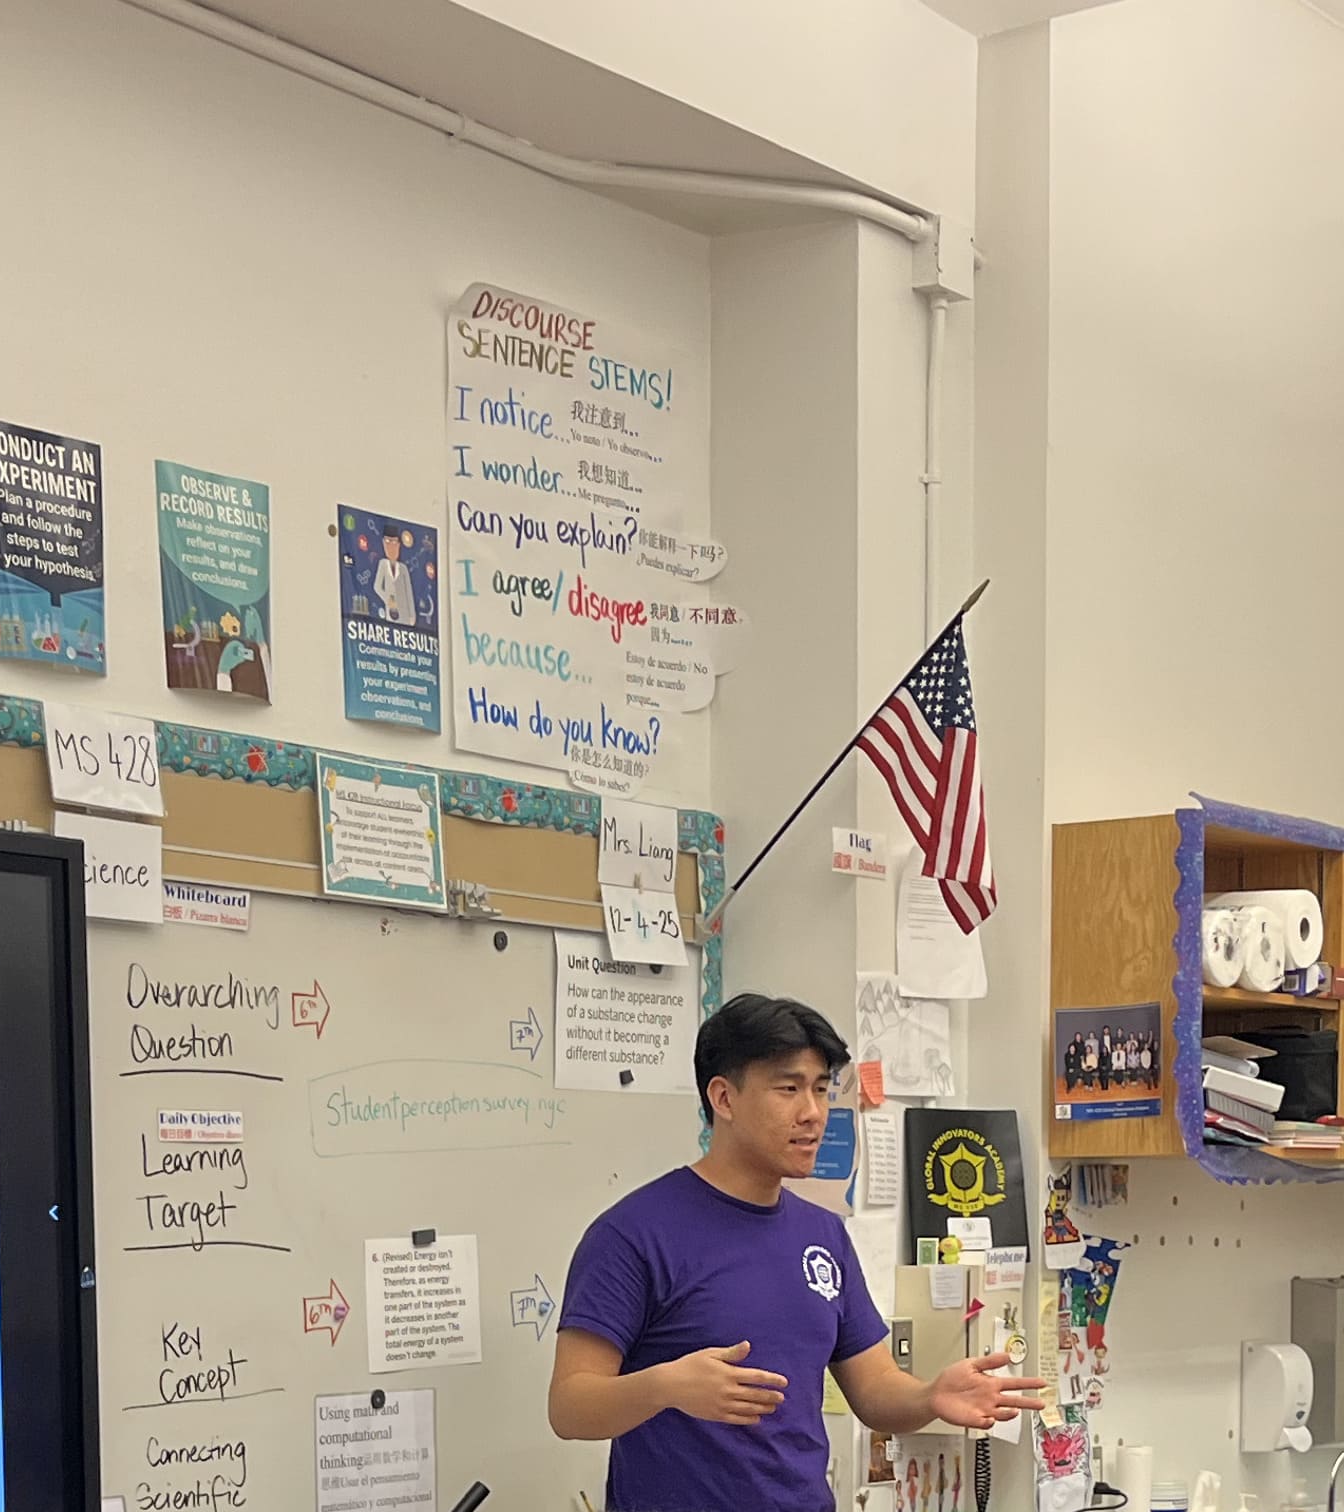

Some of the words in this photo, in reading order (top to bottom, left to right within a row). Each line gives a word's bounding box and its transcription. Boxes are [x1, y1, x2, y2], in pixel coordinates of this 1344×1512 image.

[471, 290, 597, 350] DISCOURSE
[457, 319, 576, 379] SENTENCE
[588, 355, 673, 412] STEMS!
[454, 385, 473, 422] I
[71, 448, 95, 477] AN
[453, 445, 474, 477] I
[180, 474, 239, 506] OBSERVE
[241, 488, 253, 508] &
[1, 510, 25, 527] and
[27, 514, 62, 535] follow
[64, 522, 83, 540] the
[25, 496, 33, 509] a
[35, 499, 93, 522] procedure
[160, 492, 215, 521] RECORD
[217, 505, 269, 534] RESULTS
[6, 533, 40, 552] steps
[42, 538, 54, 553] to
[56, 541, 79, 558] test
[457, 500, 503, 537] Can
[509, 512, 548, 549] you
[556, 512, 639, 568] explain?
[3, 553, 32, 569] your
[34, 554, 96, 582] hypothesis.
[456, 559, 479, 596] I
[567, 573, 648, 644] disagree
[347, 620, 392, 645] SHARE
[393, 628, 439, 657] RESULTS
[469, 686, 519, 731] How
[529, 699, 553, 739] do
[559, 717, 593, 756] you
[601, 702, 661, 756] know?
[56, 729, 99, 776] MS
[108, 731, 156, 788] 428
[603, 816, 632, 855] Mrs.
[638, 820, 675, 882] Liang
[84, 855, 149, 887] cience
[164, 884, 247, 908] Whiteboard
[567, 954, 589, 970] Unit
[592, 957, 636, 975] Question
[127, 963, 281, 1030] Overarching
[567, 983, 589, 999] How
[591, 987, 608, 1000] can
[610, 987, 626, 1002] the
[627, 991, 684, 1007] appearance
[566, 1005, 577, 1018] of
[579, 1007, 585, 1019] a
[587, 1006, 636, 1024] substance
[637, 1011, 673, 1029] change
[129, 1023, 234, 1063] Question
[566, 1025, 603, 1040] without
[605, 1028, 612, 1041] it
[614, 1027, 661, 1048] becoming
[663, 1035, 670, 1046] a
[565, 1045, 608, 1062] different
[609, 1048, 665, 1065] substance?
[159, 1111, 188, 1125] Daily
[191, 1111, 241, 1126] Objective
[141, 1133, 248, 1190] Learning
[136, 1190, 237, 1252] Target
[162, 1322, 203, 1361] Key
[159, 1349, 248, 1404] Concept
[319, 1406, 351, 1423] Using
[319, 1425, 393, 1447] computational
[146, 1436, 247, 1487] Connecting
